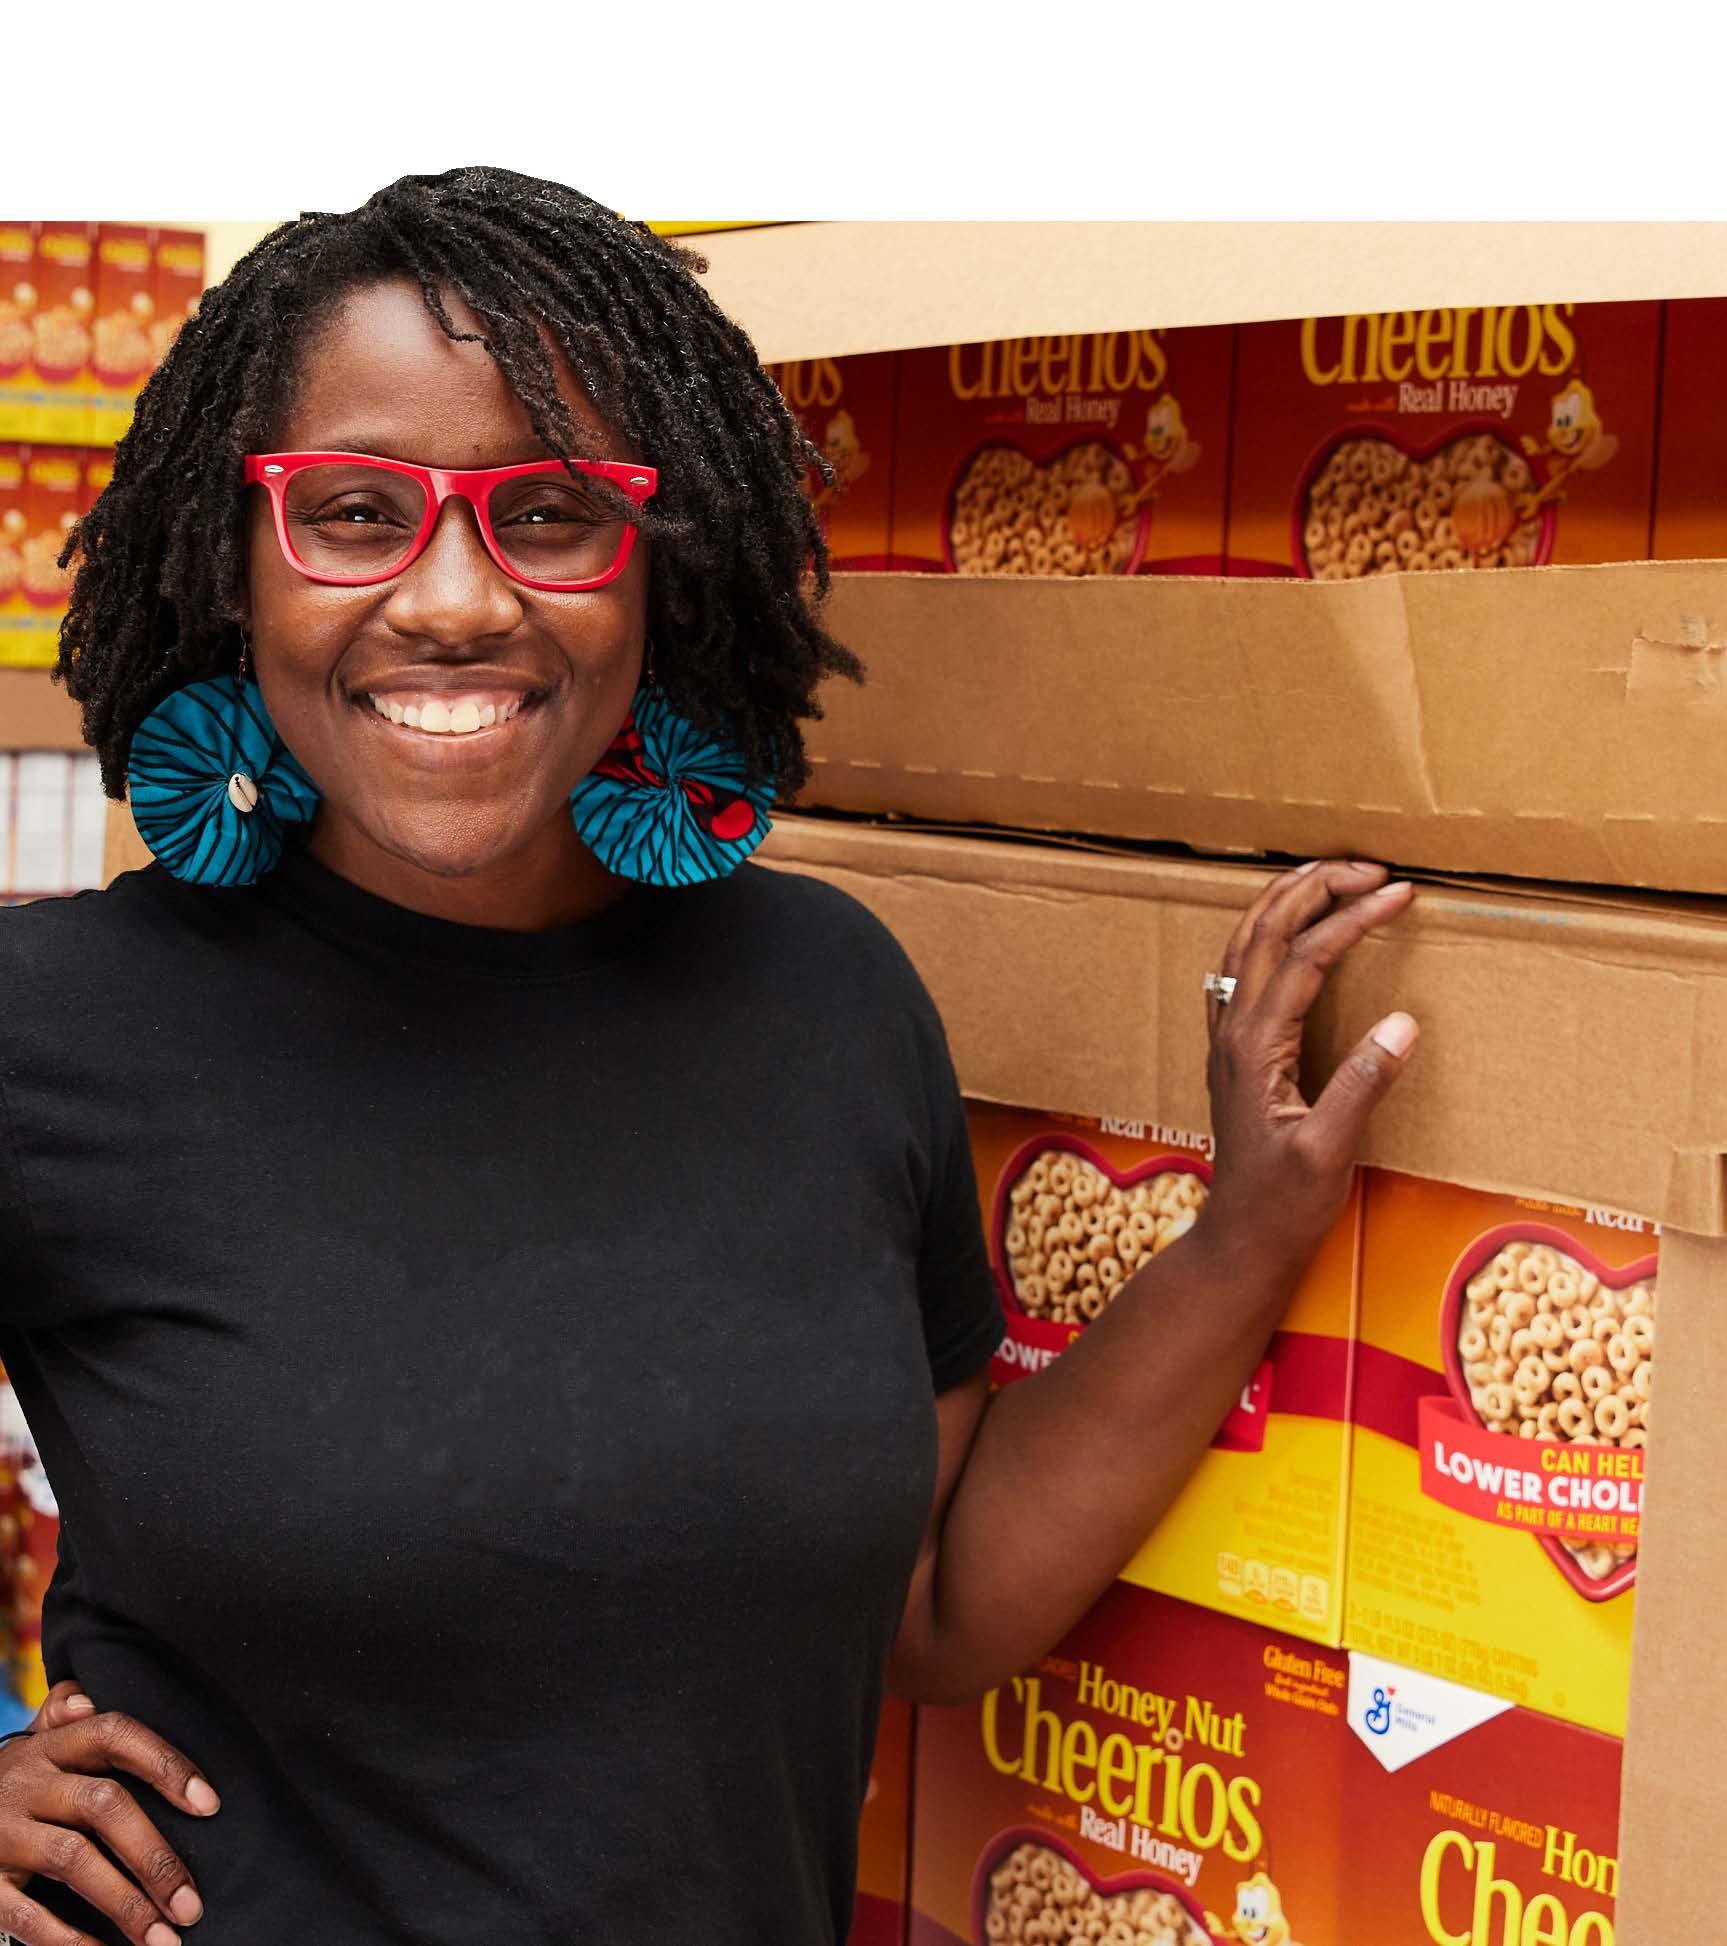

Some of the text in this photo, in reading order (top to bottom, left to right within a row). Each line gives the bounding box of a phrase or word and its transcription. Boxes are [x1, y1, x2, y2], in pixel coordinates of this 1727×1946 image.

[1026, 398, 1063, 425] Real
[1066, 396, 1121, 428] Honey
[1400, 382, 1442, 414] Real
[1450, 380, 1518, 419] Honey
[1434, 1441, 1543, 1504] LOWER
[1541, 1448, 1590, 1475] CAN
[1496, 1500, 1514, 1520] AS
[1515, 1503, 1545, 1527] PART
[1547, 1509, 1564, 1529] OF
[1565, 1511, 1577, 1531] A
[1577, 1513, 1618, 1534] HEART
[1263, 1644, 1313, 1680] Gluten
[1313, 1659, 1346, 1690] Free
[1078, 1660, 1248, 1759] Honey Nut
[981, 1675, 1264, 1864] Cheerios
[1079, 1804, 1127, 1852] Real
[1131, 1823, 1204, 1888] Honey
[1429, 1790, 1488, 1829] NATURALLY
[1488, 1811, 1545, 1850] FLAVORED
